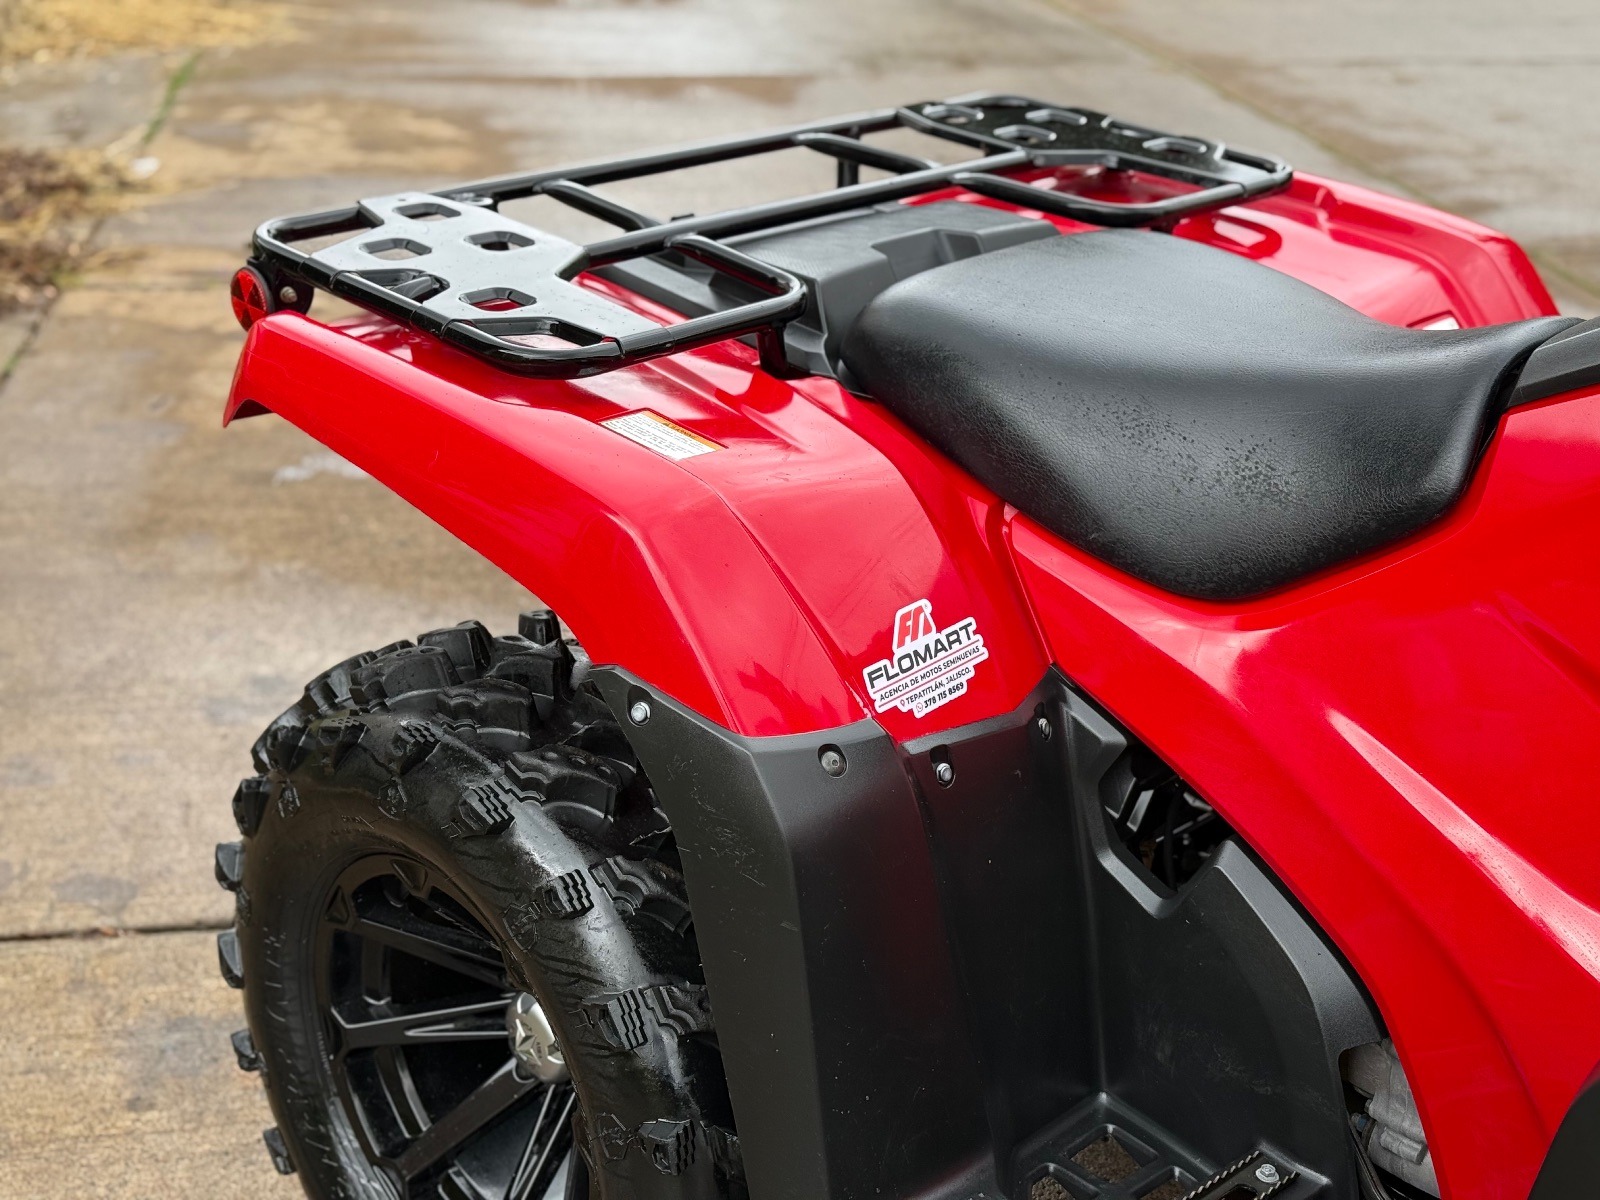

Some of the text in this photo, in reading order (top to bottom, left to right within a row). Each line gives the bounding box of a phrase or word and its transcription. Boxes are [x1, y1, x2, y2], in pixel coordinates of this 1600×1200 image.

[867, 622, 973, 689] FLOMART
[880, 645, 980, 702] AGENCIA DE MOTOS SEMINUEVAS
[906, 666, 972, 705] TEPATITLÁN, JALISCO.
[924, 681, 964, 709] 378 115 8569
